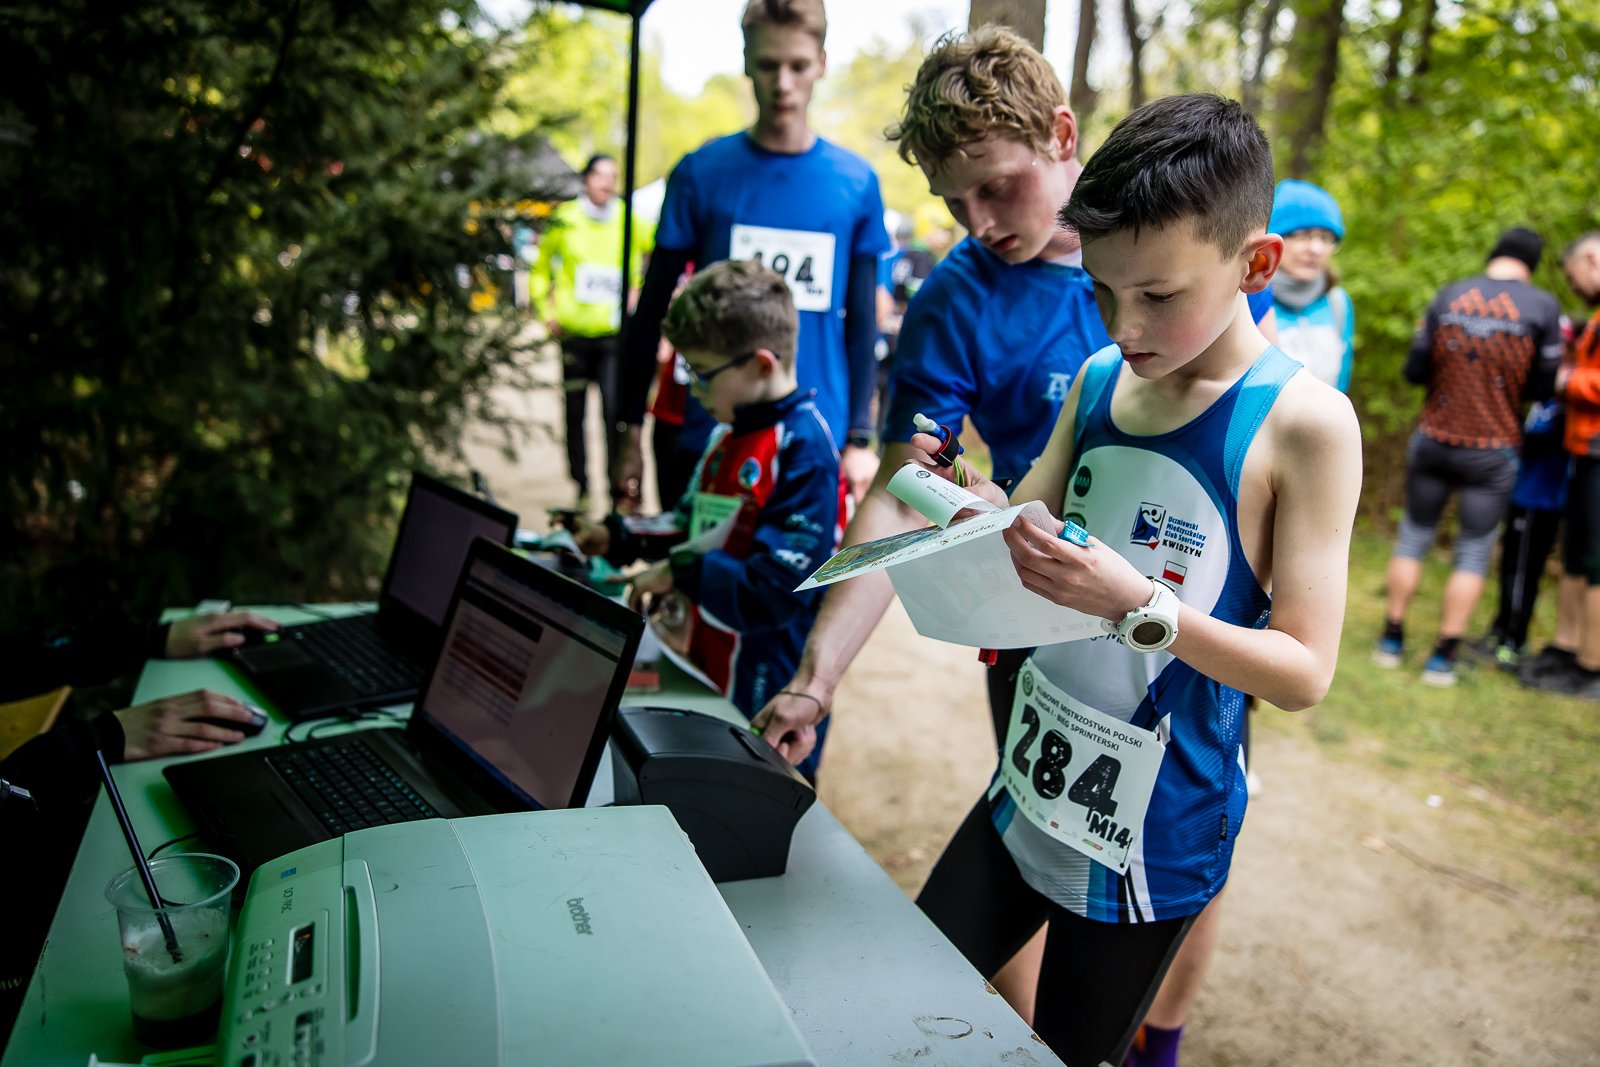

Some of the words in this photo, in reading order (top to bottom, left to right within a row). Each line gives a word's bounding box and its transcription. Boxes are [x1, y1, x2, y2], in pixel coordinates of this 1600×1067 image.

[1164, 530, 1177, 539] Klub
[1178, 535, 1205, 549] Sportowy
[1166, 524, 1206, 541] Międzyszkolny
[1168, 516, 1199, 531] Uczniowski
[1162, 539, 1202, 557] KWIDZYN
[1057, 716, 1069, 728] BIEG
[1071, 724, 1120, 751] SPRINTERSKI
[1060, 702, 1112, 736] MISTRZOSTWA
[1112, 730, 1143, 748] POLSKI
[1012, 703, 1121, 821] 284
[1088, 813, 1130, 849] M14
[566, 897, 594, 935] brother
